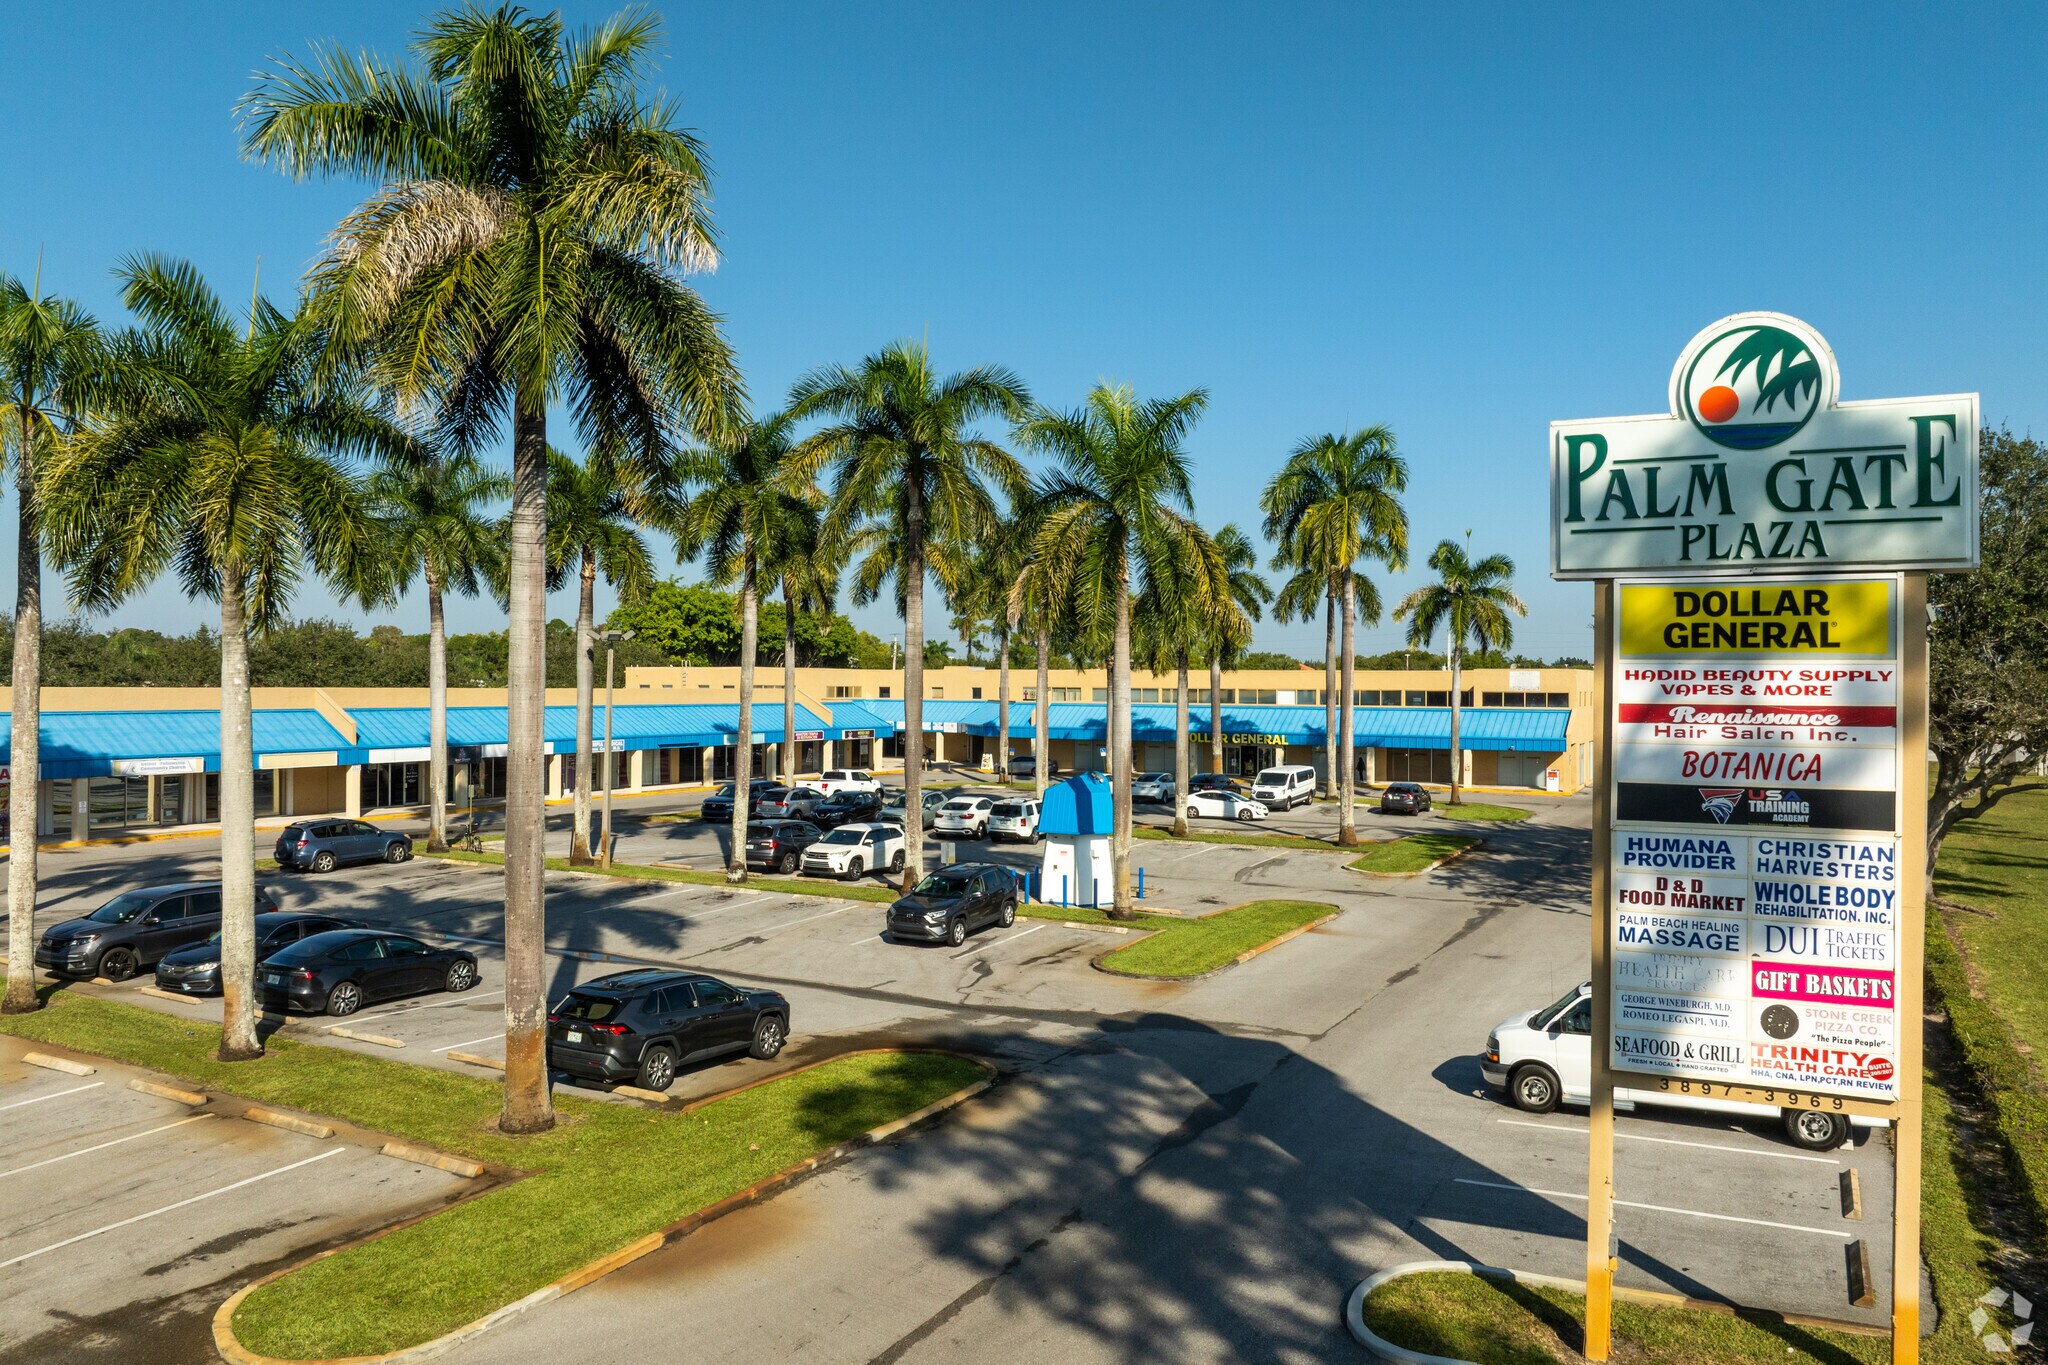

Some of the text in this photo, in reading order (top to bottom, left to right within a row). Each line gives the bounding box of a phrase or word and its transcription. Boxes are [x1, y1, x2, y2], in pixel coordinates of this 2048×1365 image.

[1564, 413, 1961, 523] PALM GATE
[1680, 520, 1829, 561] PLAZA
[1674, 589, 1830, 618] DOLLAR
[1663, 621, 1842, 649] GENERAL
[1625, 669, 1894, 683] HADID BEAUTY SUPPLY
[1661, 684, 1833, 697] VAPES & MORE
[1668, 706, 1841, 727] Renaissance
[1189, 733, 1288, 745] OLLR GENERAL
[1654, 725, 1707, 739] Hair
[1809, 728, 1857, 742] Inc.
[1682, 751, 1822, 782] BOTANICA
[1748, 789, 1801, 801] USA
[1748, 800, 1810, 814] TRAINING
[1772, 814, 1810, 823] ACADEMY
[1628, 837, 1731, 854] HUMANA
[1758, 840, 1894, 863] CHRISTIAN
[1624, 852, 1736, 870] PROVIDER
[1757, 858, 1894, 881] HARVESTERS
[1656, 876, 1703, 893] D & D
[1620, 889, 1746, 912] FOOD MARKET
[1754, 881, 1895, 910] WHOLE BODY
[1619, 915, 1740, 933] PALM BEACH HEALING
[1865, 911, 1891, 924] INC.
[1618, 926, 1740, 952] MASSAGE
[1764, 924, 1820, 956] DUI
[1825, 928, 1886, 946] TRAFFIC
[1826, 943, 1885, 961] TICKETS
[1755, 970, 1892, 1000] GIFT BASKETS
[1621, 994, 1656, 1006] GEORGE
[1715, 1002, 1732, 1012] M.D.
[1622, 1010, 1659, 1022] ROMEO
[1710, 1018, 1730, 1028] M.D.
[1805, 1009, 1892, 1024] STONE CREEK
[1815, 1021, 1882, 1036] PIZZA CO.
[1615, 1035, 1745, 1064] SEAFOOD & GRILL
[1832, 1036, 1853, 1045] Pizza
[1751, 1041, 1869, 1067] TRINITY
[1700, 1065, 1729, 1073] CRAFTED
[1751, 1058, 1870, 1079] HEALTH CARE
[1869, 1062, 1891, 1070] SUITE
[1751, 1068, 1773, 1079] HHA,
[1776, 1071, 1797, 1081] CNA,
[1856, 1078, 1893, 1091] REVIEW
